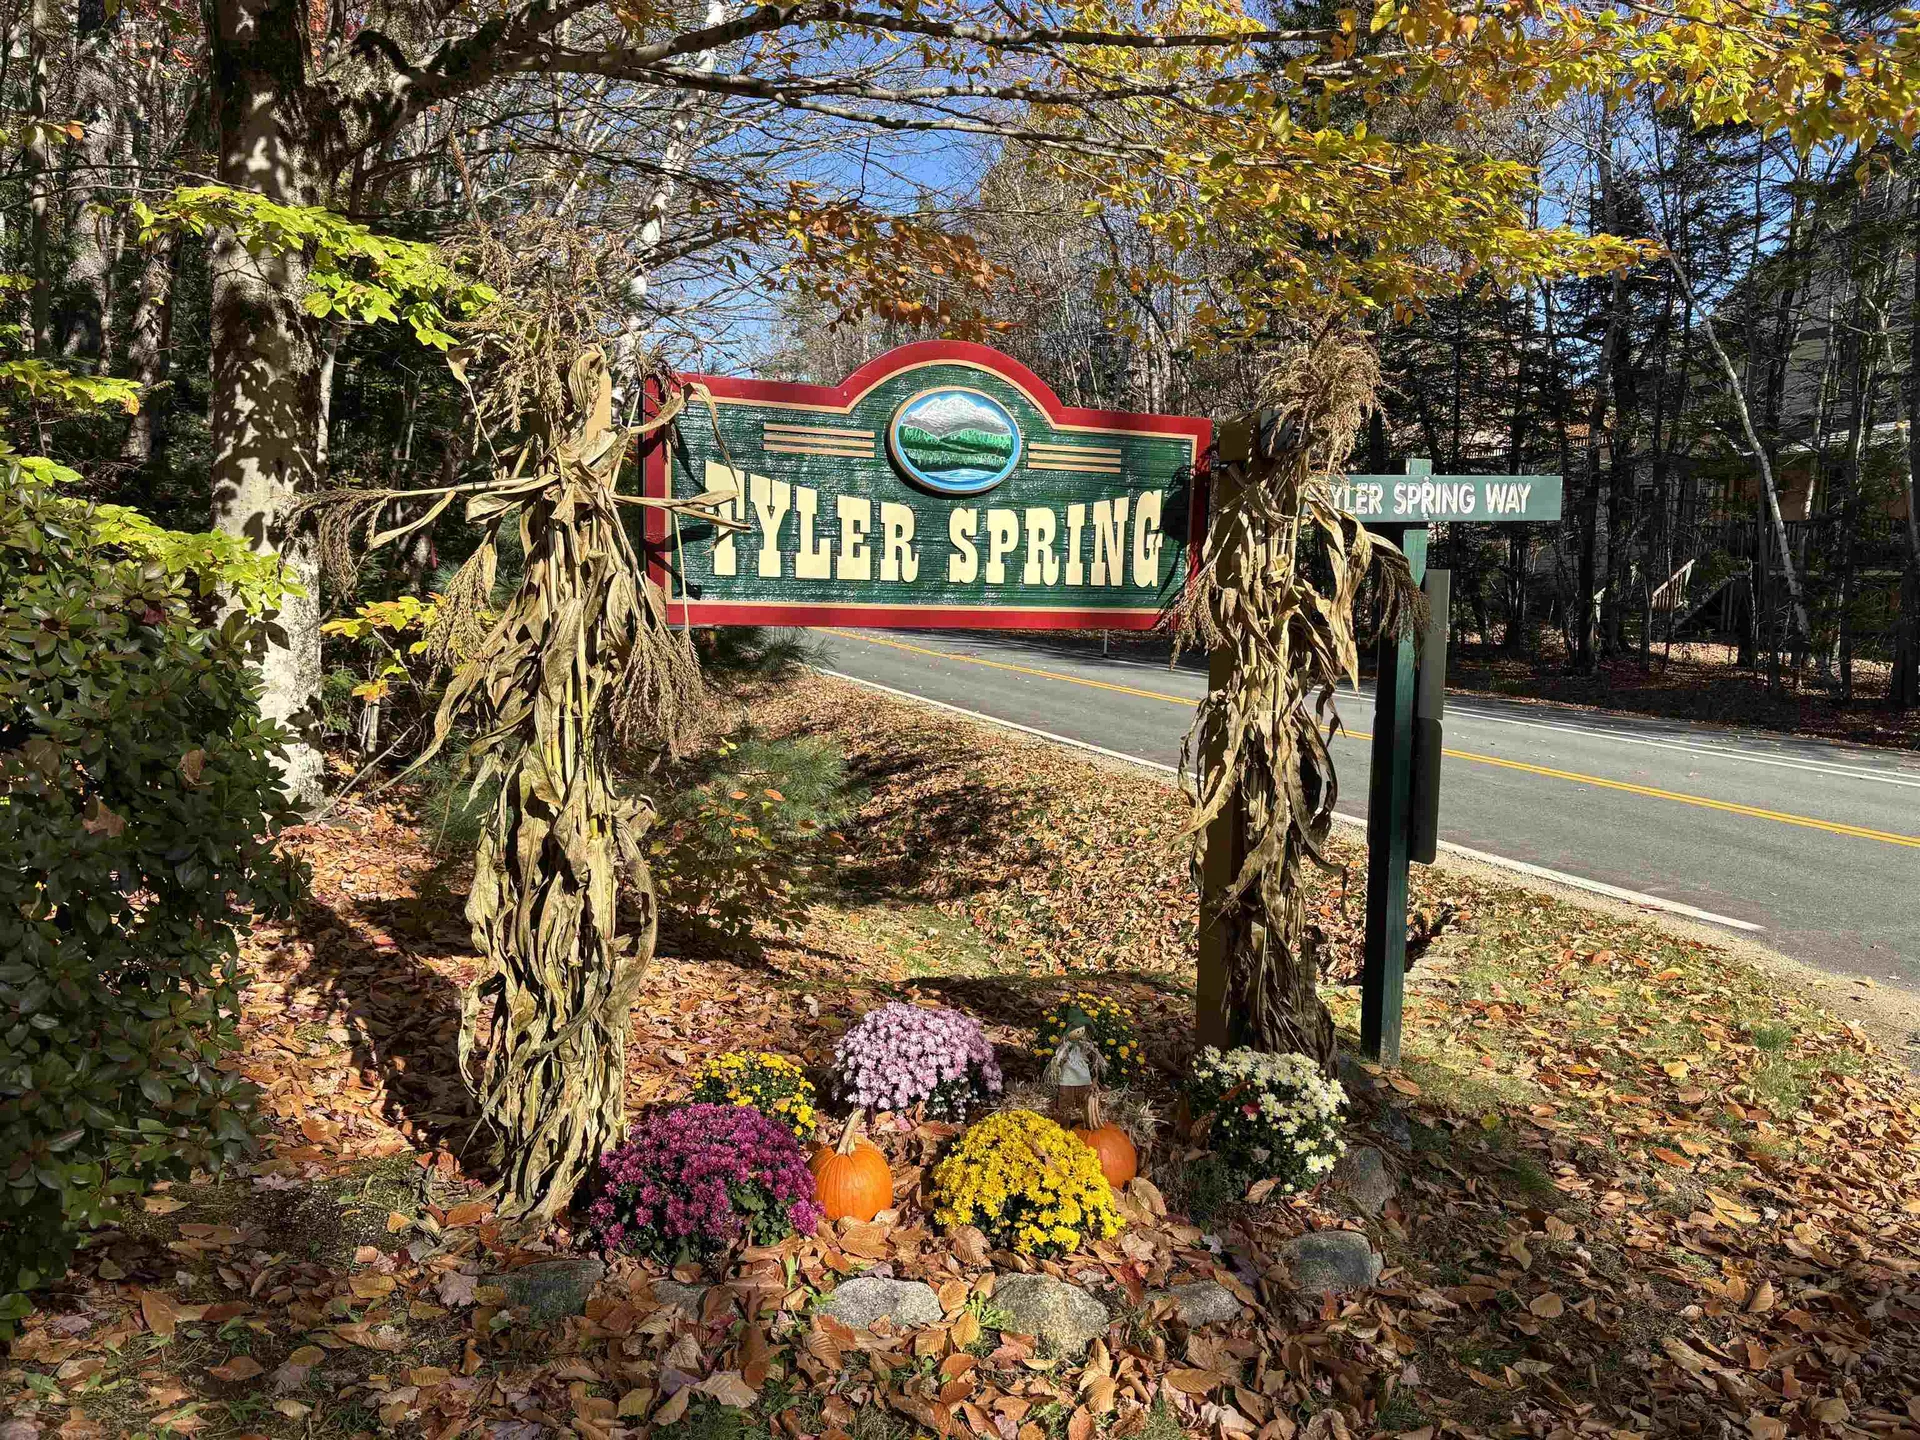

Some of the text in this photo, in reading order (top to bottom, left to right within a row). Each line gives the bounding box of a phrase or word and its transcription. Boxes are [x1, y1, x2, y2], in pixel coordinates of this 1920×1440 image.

[704, 460, 1163, 588] TYLER SPRING
[1329, 482, 1532, 515] YLER SPRING WAY
